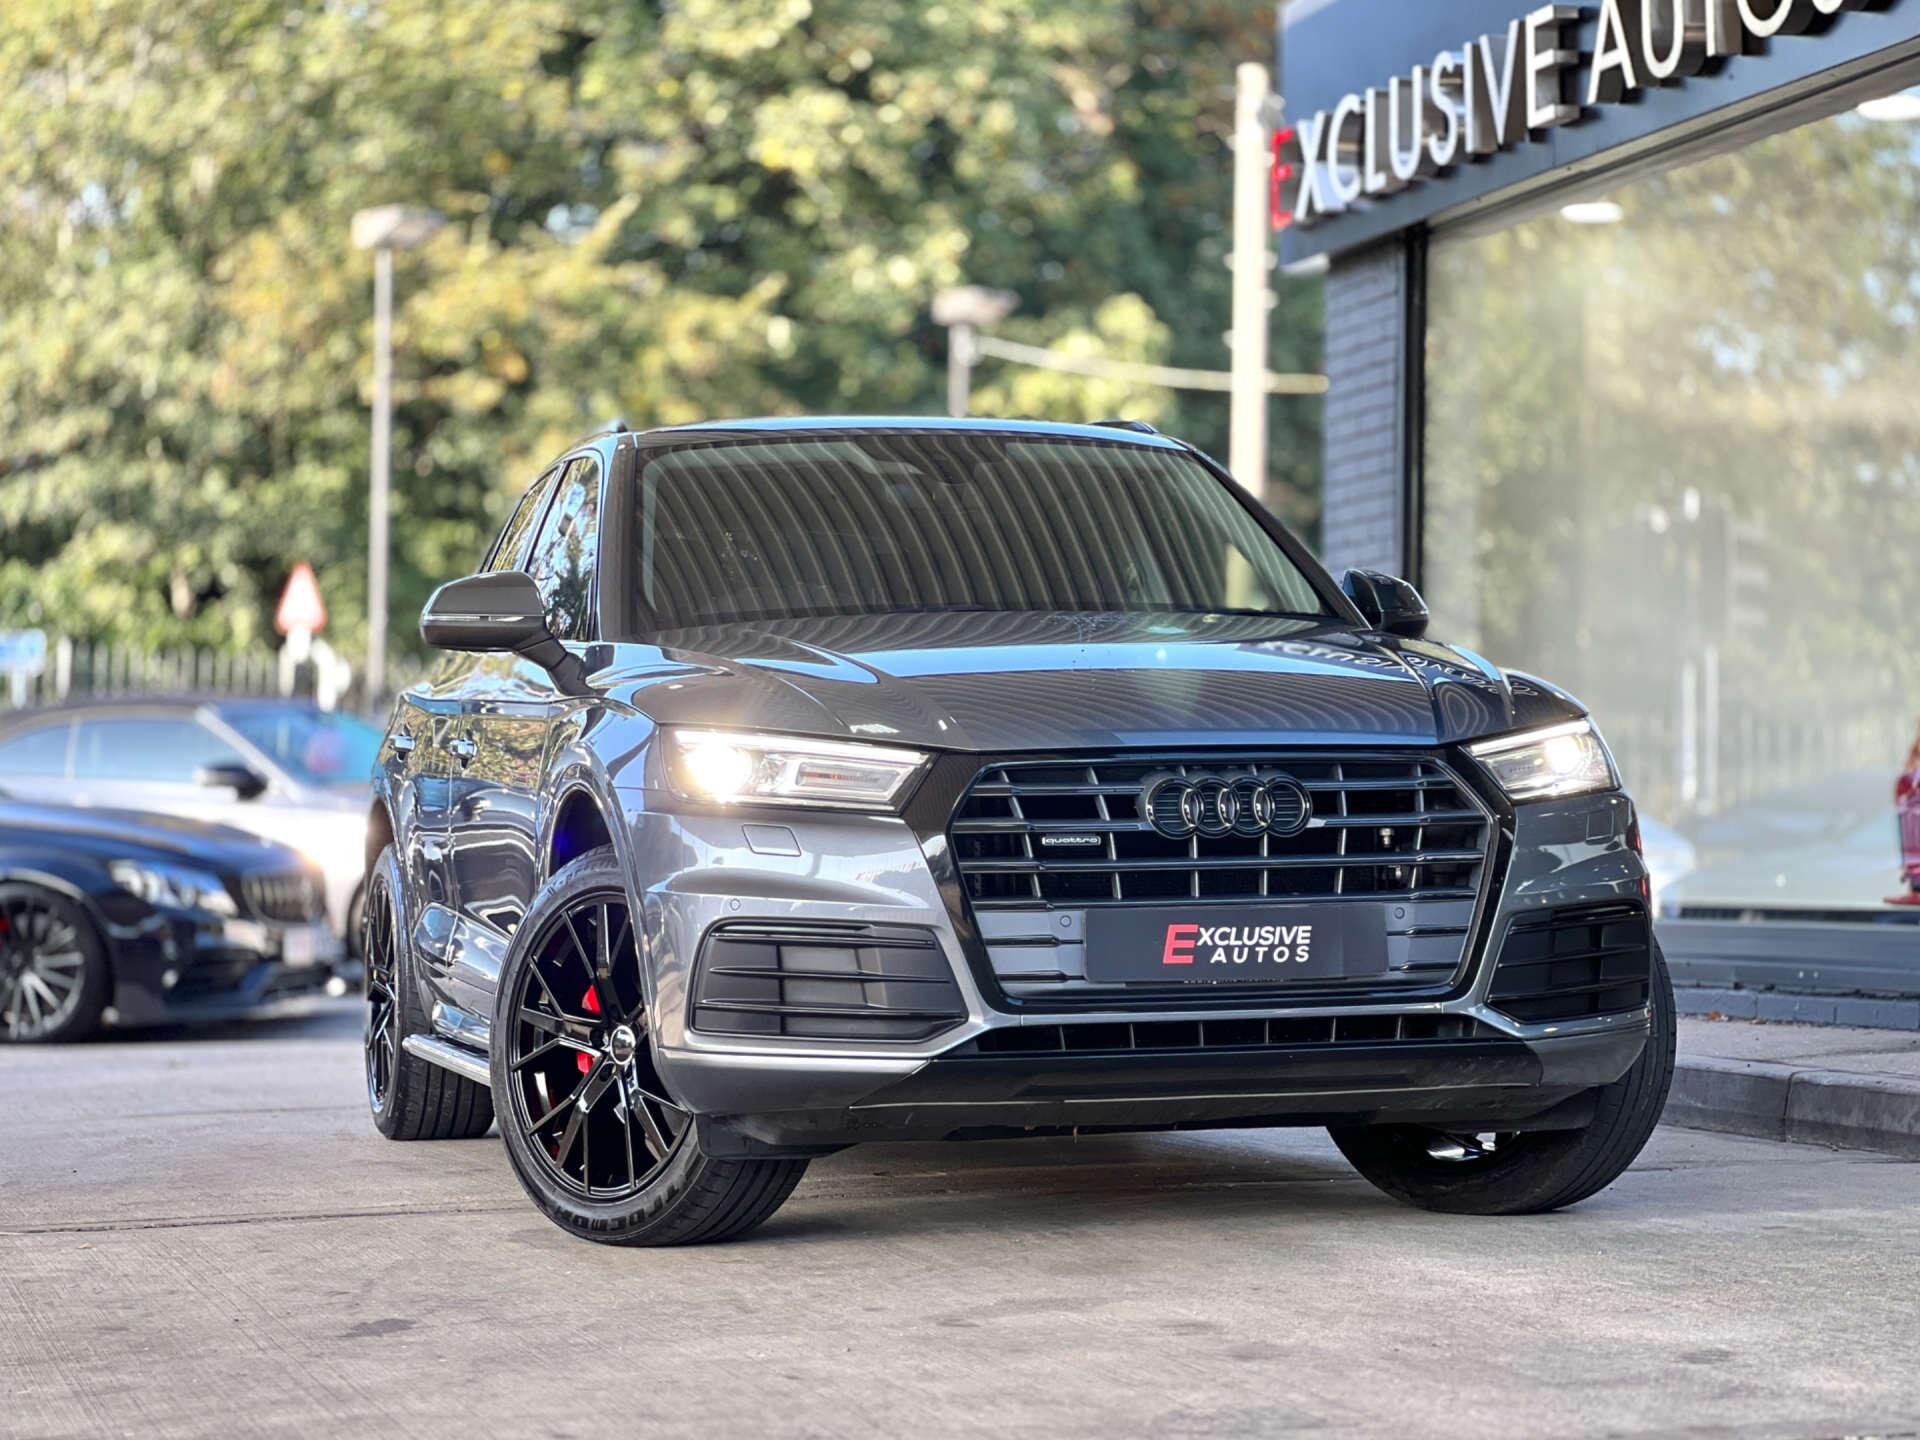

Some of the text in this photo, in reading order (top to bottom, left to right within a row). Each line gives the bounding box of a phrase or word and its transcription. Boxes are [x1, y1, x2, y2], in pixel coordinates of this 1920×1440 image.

[1270, 4, 1564, 230] EXCLUSIVE
[1044, 837, 1098, 845] quattro
[1162, 923, 1313, 965] EXCLUSIVE
[1209, 945, 1310, 964] AUTOS
